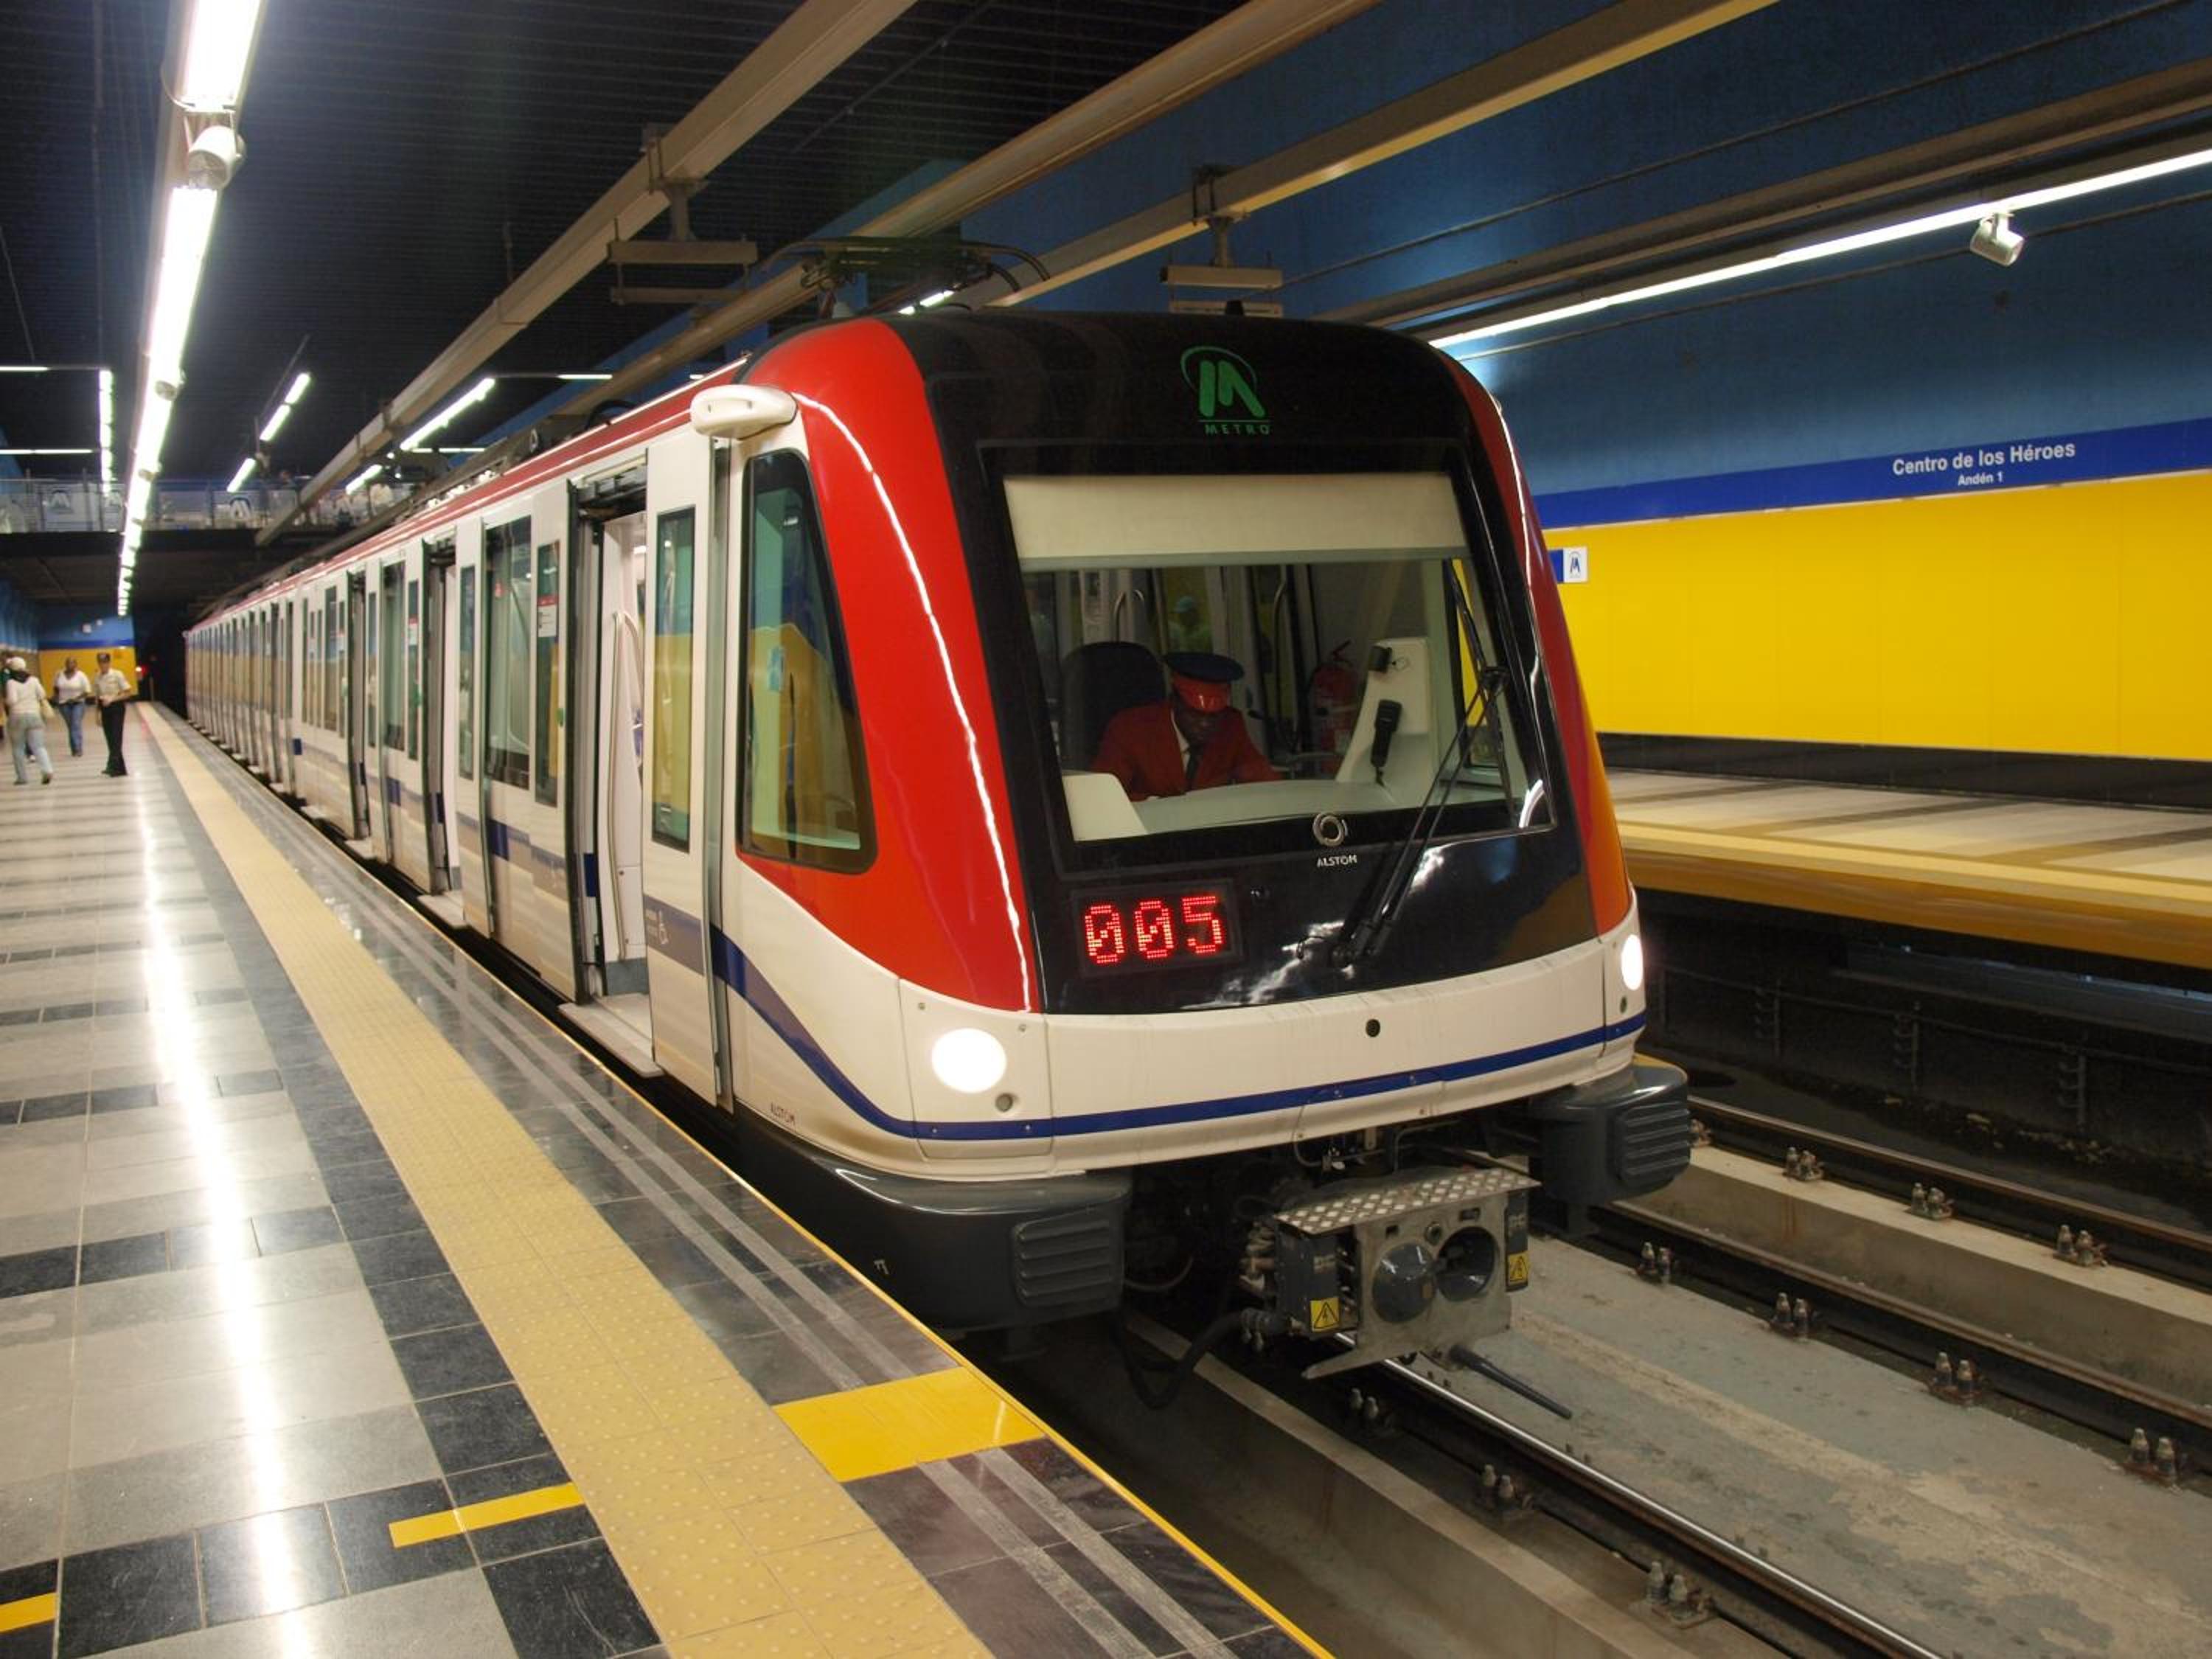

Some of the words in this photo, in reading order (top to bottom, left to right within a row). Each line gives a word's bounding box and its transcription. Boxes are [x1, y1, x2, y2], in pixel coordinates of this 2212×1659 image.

[1205, 424, 1270, 435] METRO
[1893, 456, 1948, 476] Centro
[1952, 451, 1974, 469] de
[1978, 448, 2005, 467] los
[2010, 444, 2076, 464] Héroes
[1958, 472, 1994, 486] Andén
[1996, 472, 2003, 483] 1
[1316, 855, 1357, 868] ALSTOM
[1085, 895, 1223, 964] 005
